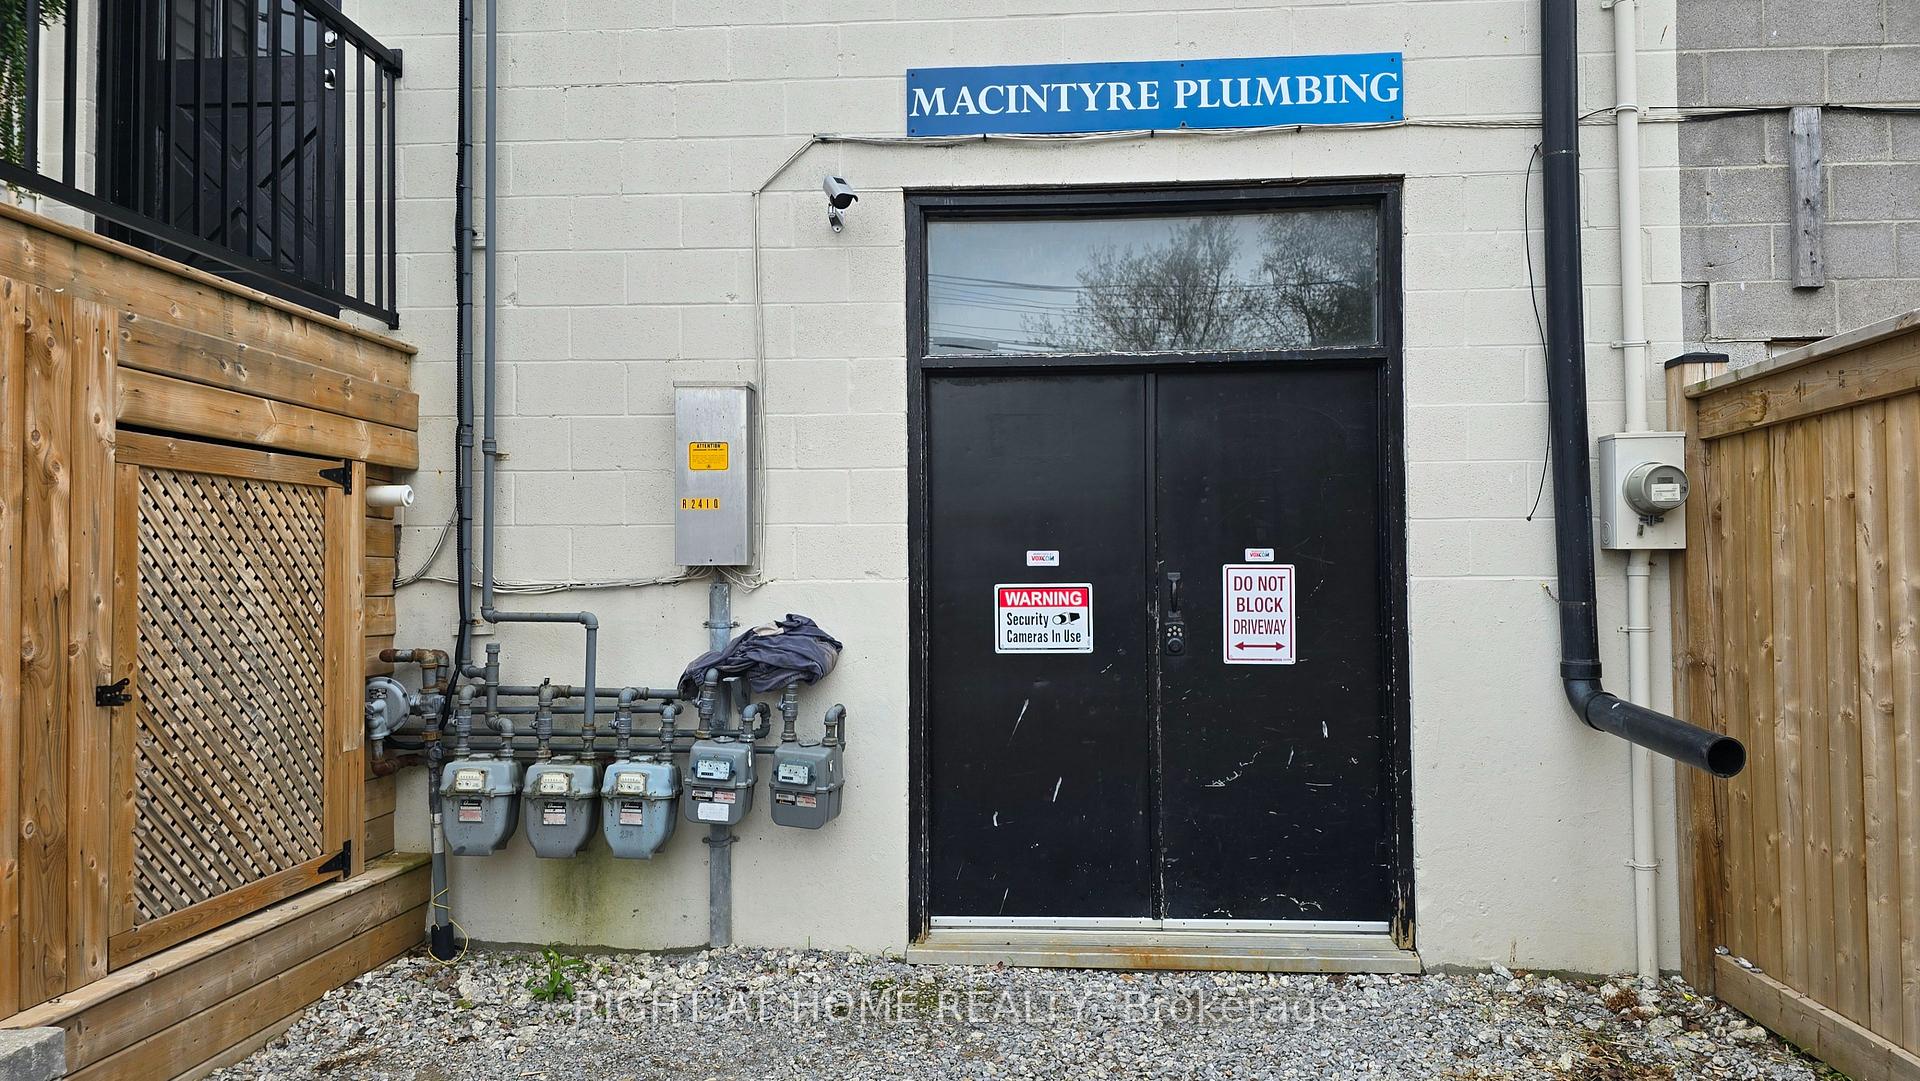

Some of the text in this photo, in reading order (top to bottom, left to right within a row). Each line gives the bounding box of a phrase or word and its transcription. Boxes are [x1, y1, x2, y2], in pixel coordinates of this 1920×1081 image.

[909, 72, 1400, 117] MACINTYRE PLUMBING
[1233, 575, 1286, 592] DO NOT
[1004, 590, 1083, 606] WARNING
[1236, 597, 1284, 613] BLOCK
[1006, 612, 1049, 629] Security
[1233, 619, 1287, 635] DRIVEWAY
[1006, 629, 1082, 643] Cameras In Use
